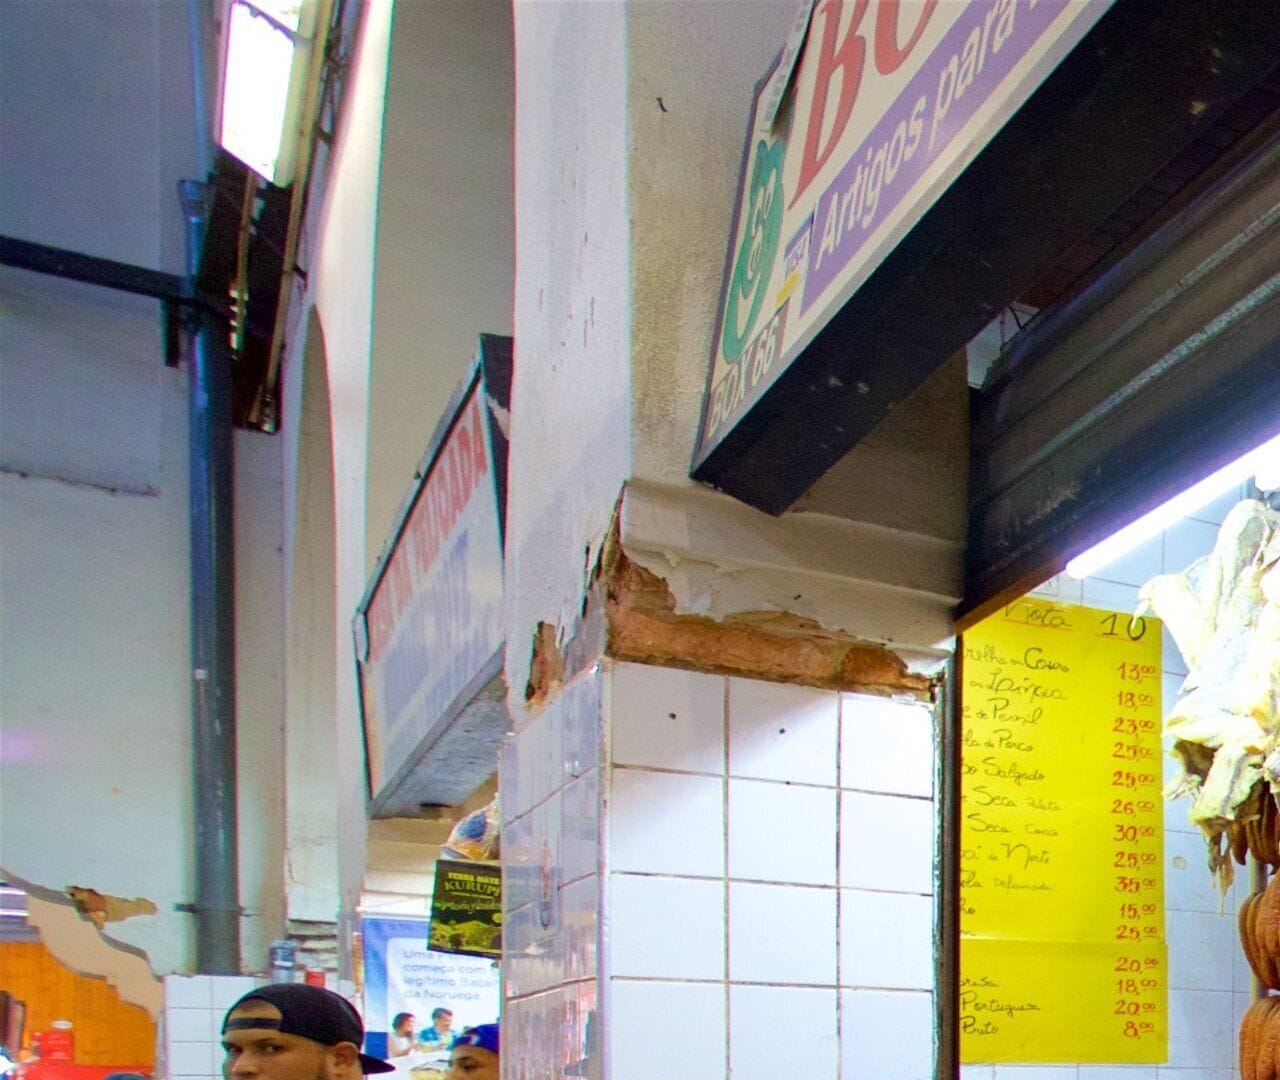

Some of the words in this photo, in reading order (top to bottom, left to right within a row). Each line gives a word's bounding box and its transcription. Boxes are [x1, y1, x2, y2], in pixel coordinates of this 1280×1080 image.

[814, 95, 927, 271] Artigos
[928, 0, 1017, 150] para
[752, 314, 780, 388] 66
[972, 785, 1018, 808] Seca
[982, 756, 1046, 787] Salgado
